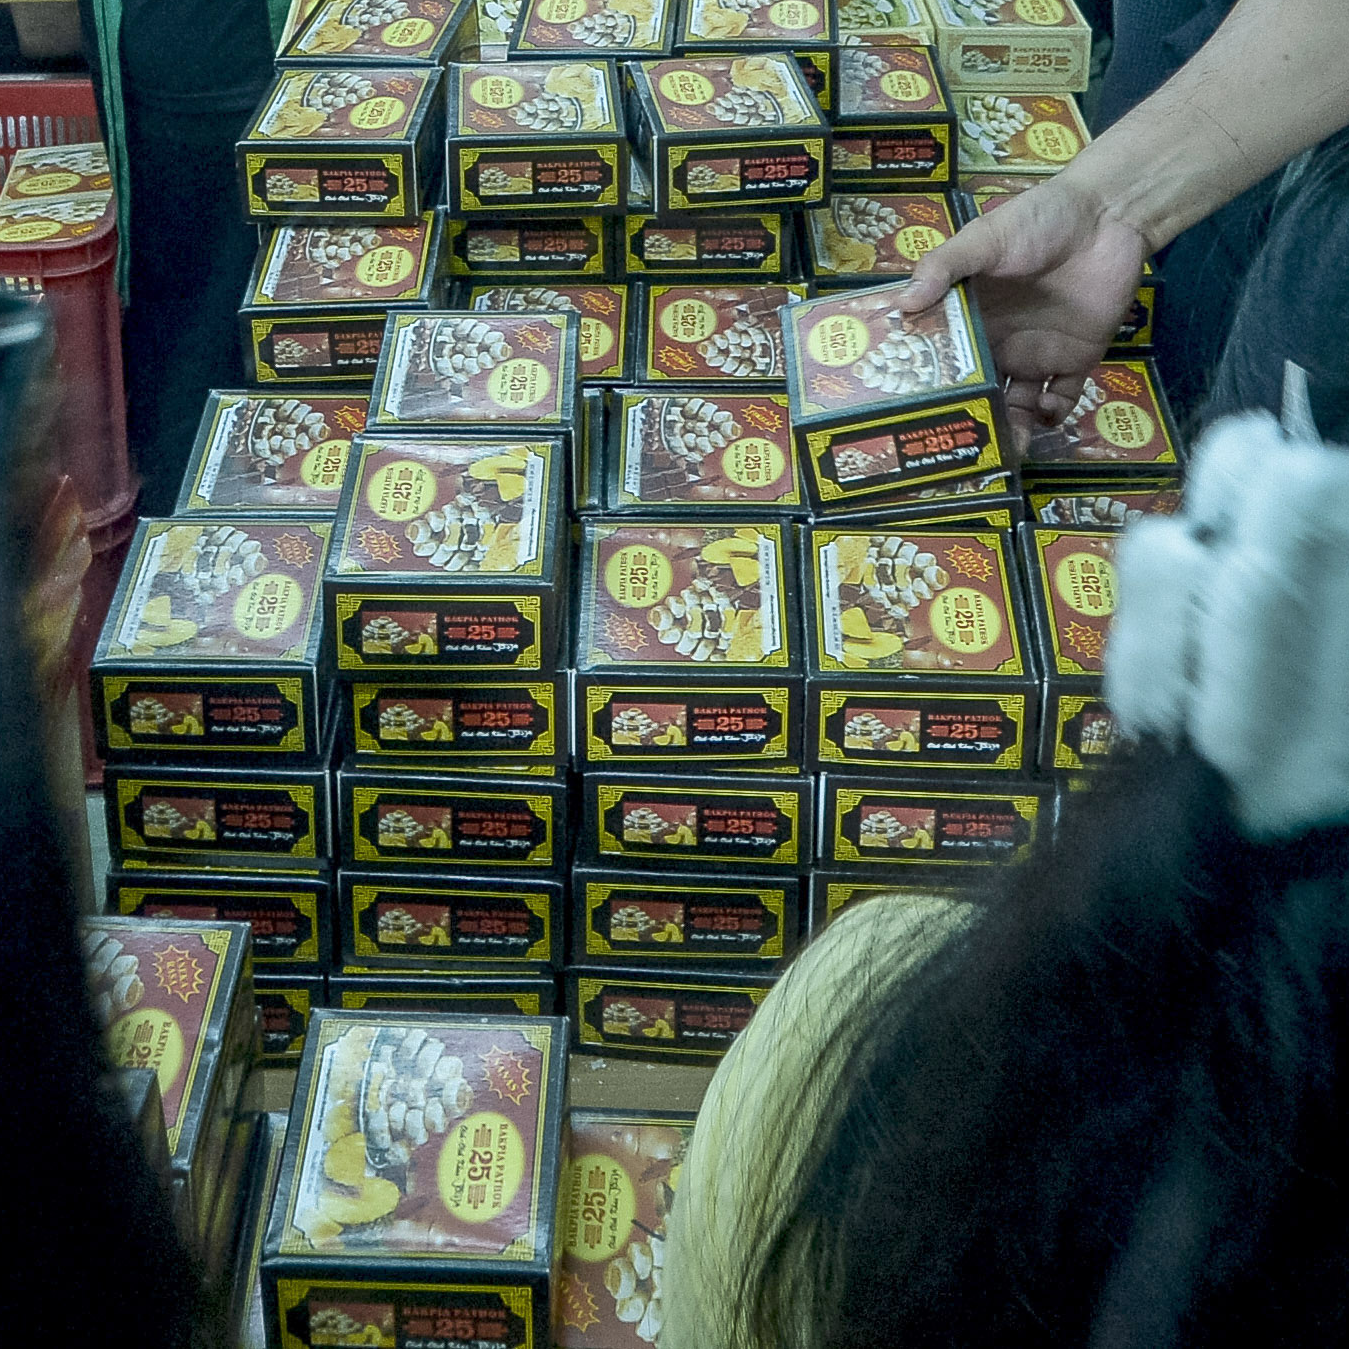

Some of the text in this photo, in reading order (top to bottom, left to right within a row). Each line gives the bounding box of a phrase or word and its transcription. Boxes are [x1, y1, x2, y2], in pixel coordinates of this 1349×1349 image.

[1031, 55, 1053, 67] 25
[894, 147, 917, 160] 25
[557, 169, 582, 183] 25
[764, 165, 788, 179] 25
[343, 178, 368, 192] 25
[544, 237, 566, 251] 25
[721, 238, 744, 250] 25
[682, 311, 697, 328] 25
[356, 339, 380, 354] 25
[830, 333, 847, 350] 25
[512, 375, 528, 391] 25
[1115, 417, 1132, 432] 25
[924, 434, 954, 452] 25
[322, 456, 341, 474] 25
[744, 455, 762, 470] 25
[392, 482, 412, 501] 25
[630, 566, 649, 585] 25
[1082, 574, 1100, 594] 25
[258, 596, 278, 615] 25
[955, 609, 974, 630] 25
[467, 625, 496, 640] 25
[232, 707, 260, 722] 25
[482, 712, 510, 727] 25
[715, 717, 744, 731] 25
[949, 724, 978, 739] 25
[244, 813, 271, 828] 25
[704, 809, 777, 818] BAKPIA PATHOK
[482, 821, 508, 836] 25
[726, 819, 753, 834] 25
[964, 822, 991, 837] 25
[481, 919, 507, 934] 25
[713, 916, 740, 930] 25
[166, 961, 178, 987] RASA
[177, 957, 189, 988] ANEKA
[495, 1059, 517, 1091] NANAS
[468, 1149, 493, 1182] 25
[492, 1123, 508, 1208] BAKPIA PATHOK
[567, 1166, 582, 1247] BAKPIA PATHOK
[582, 1192, 606, 1223] 25
[434, 1318, 475, 1339] 25
